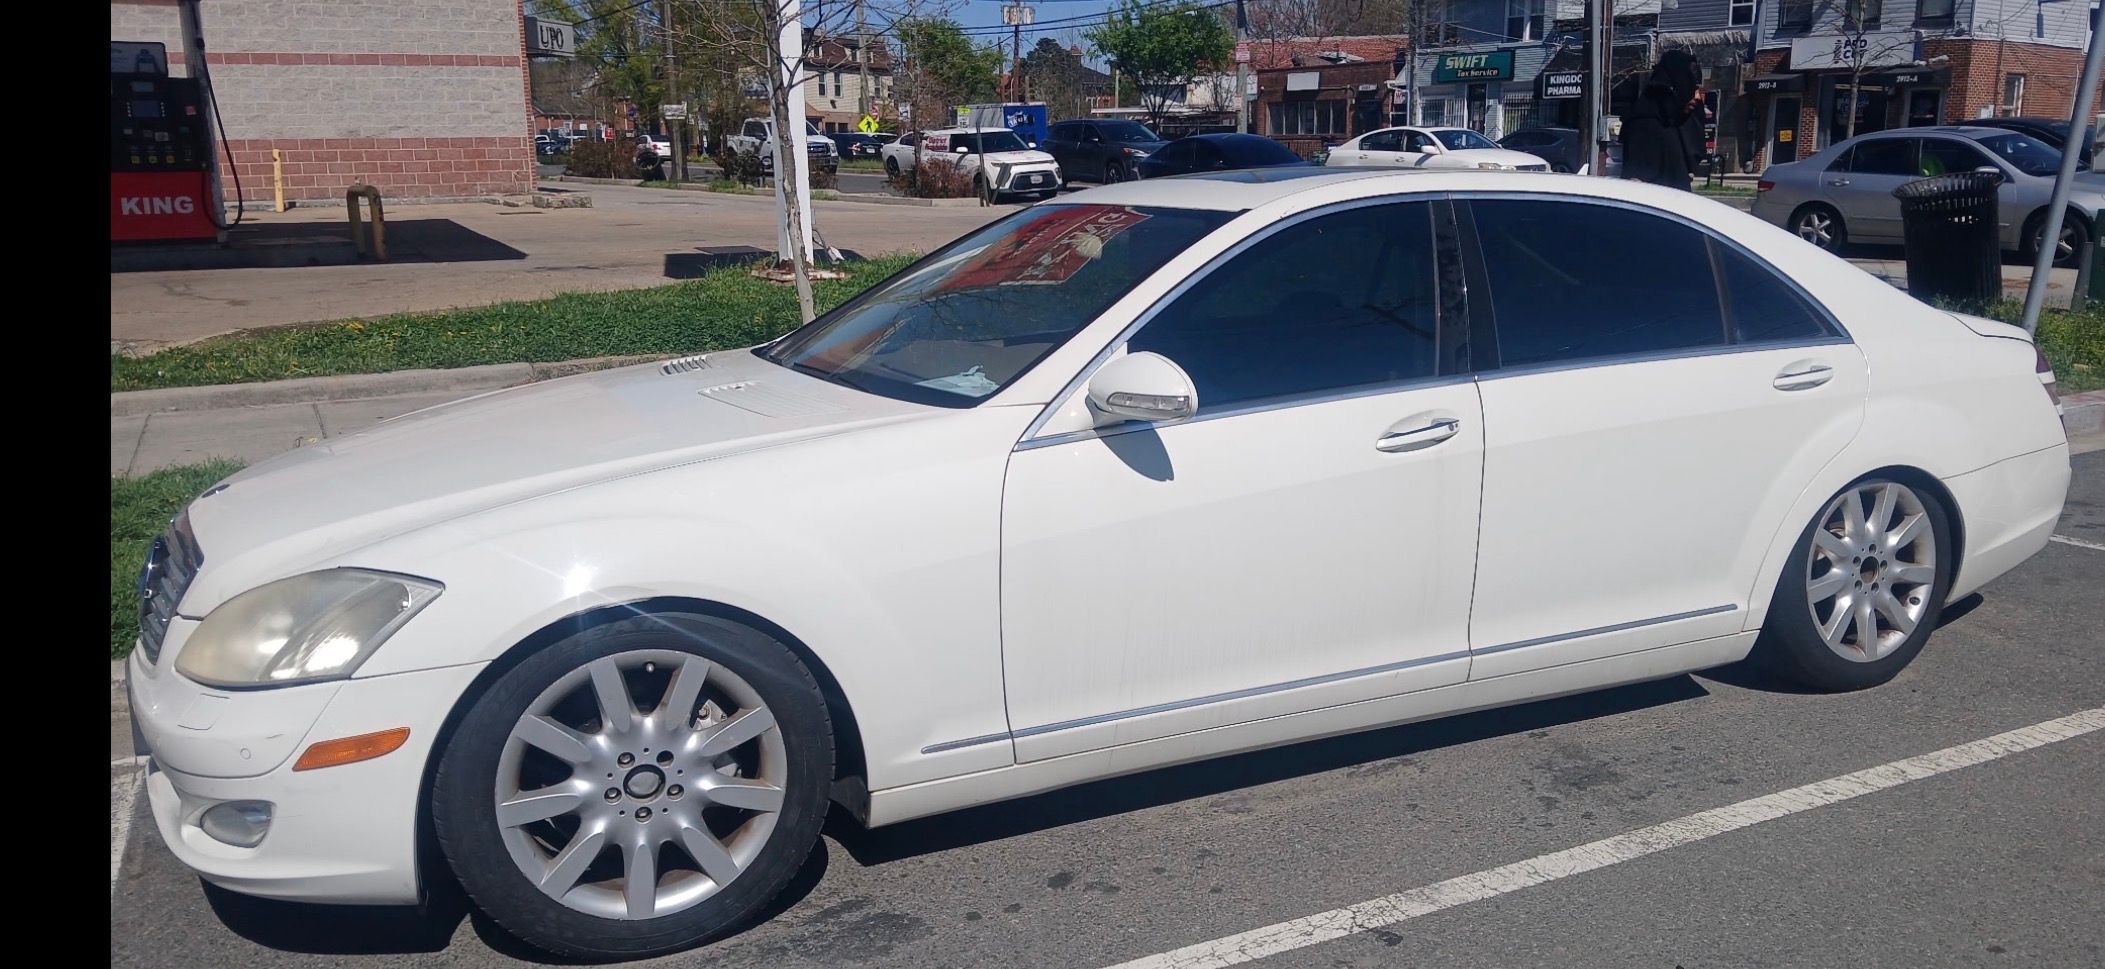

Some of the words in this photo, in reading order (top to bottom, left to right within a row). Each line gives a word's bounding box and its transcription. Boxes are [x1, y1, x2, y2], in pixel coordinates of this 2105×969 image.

[1445, 55, 1488, 69] SWIFT
[1457, 69, 1469, 77] Tax
[1470, 68, 1498, 77] Service
[121, 196, 194, 215] KING
